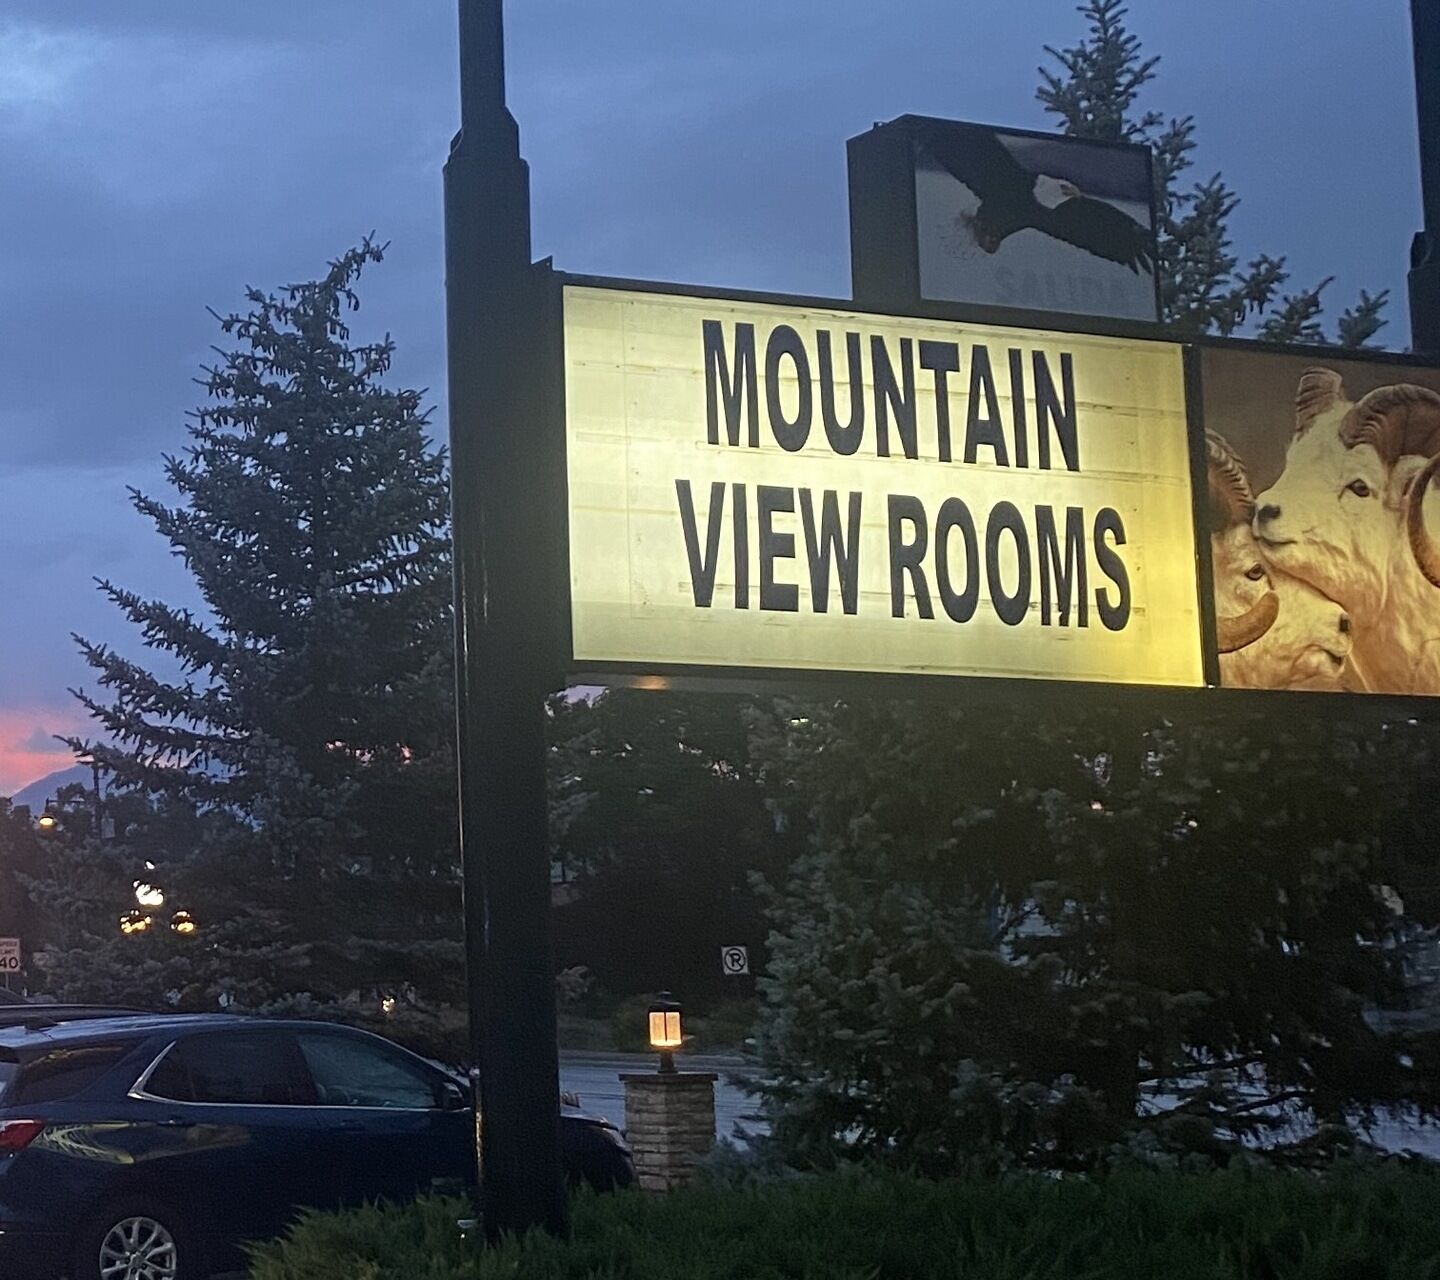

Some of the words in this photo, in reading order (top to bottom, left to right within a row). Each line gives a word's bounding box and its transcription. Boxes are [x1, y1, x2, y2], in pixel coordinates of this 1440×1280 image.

[701, 319, 1080, 472] MOUNTAIN
[676, 478, 863, 615] VIEW
[889, 495, 1132, 633] ROOMS
